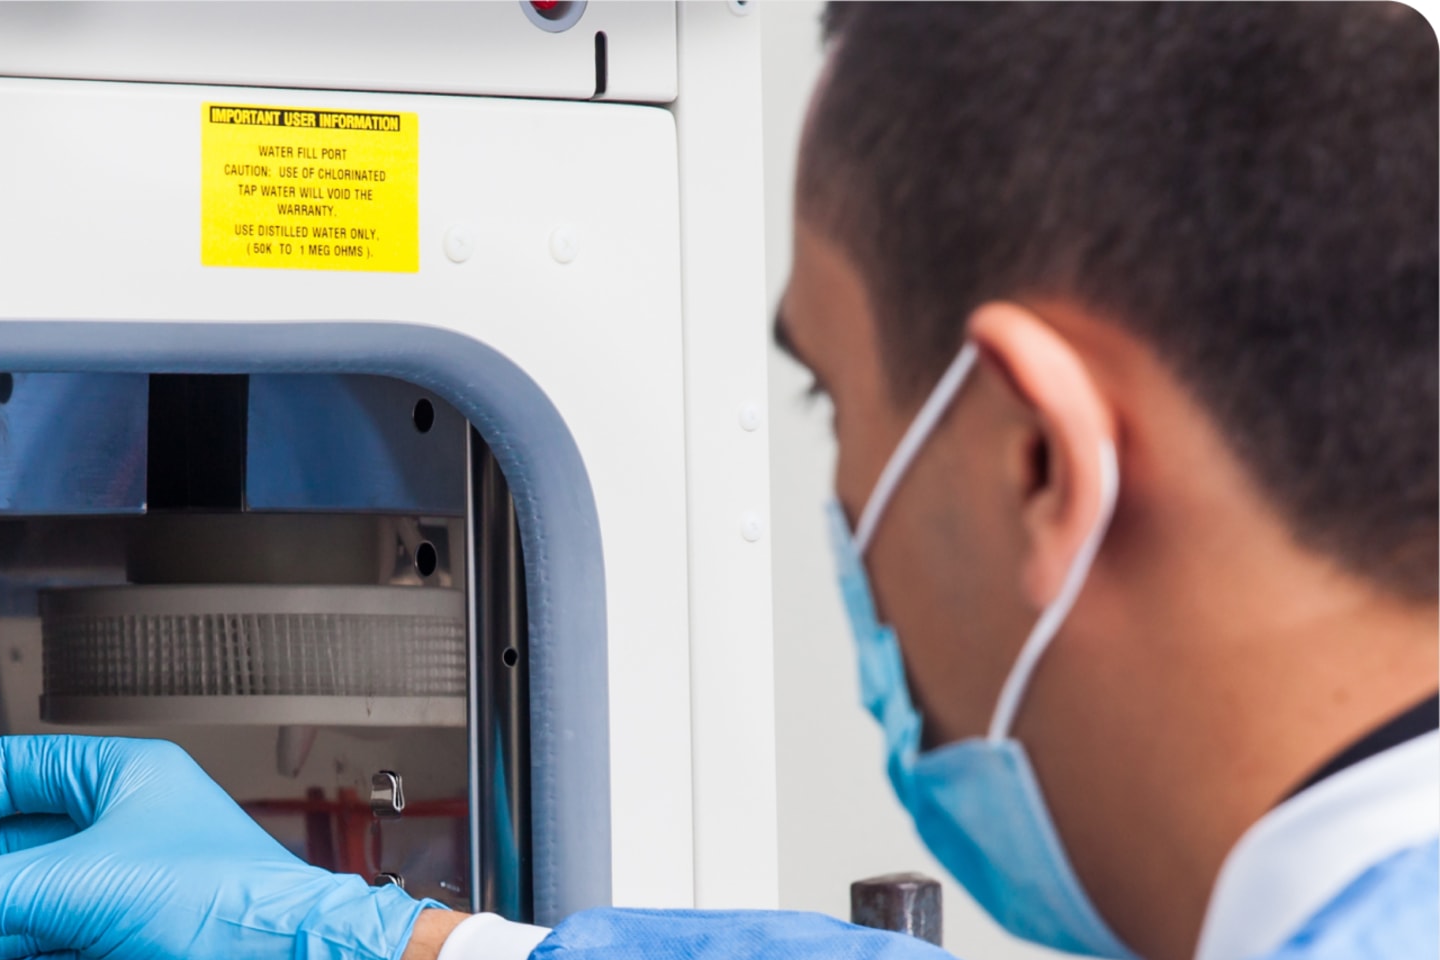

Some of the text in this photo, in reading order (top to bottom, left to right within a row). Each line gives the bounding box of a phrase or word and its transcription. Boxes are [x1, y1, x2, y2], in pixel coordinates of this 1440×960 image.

[211, 107, 399, 131] IMPORTANT USER INFORMATION
[258, 145, 347, 160] WATER FILL PORT
[224, 164, 386, 181] CAUTION: USE OF CHLORINATED
[238, 184, 372, 201] TAP WATER WILL VOID THE
[278, 204, 337, 217] WARRANTY.
[235, 224, 254, 236] USE
[258, 225, 308, 238] DISTILLED
[312, 227, 346, 239] WATER
[254, 244, 272, 254] 50K
[280, 244, 292, 255] TO
[300, 246, 304, 255] 1
[309, 245, 330, 255] MEG
[334, 246, 363, 256] OHMS
